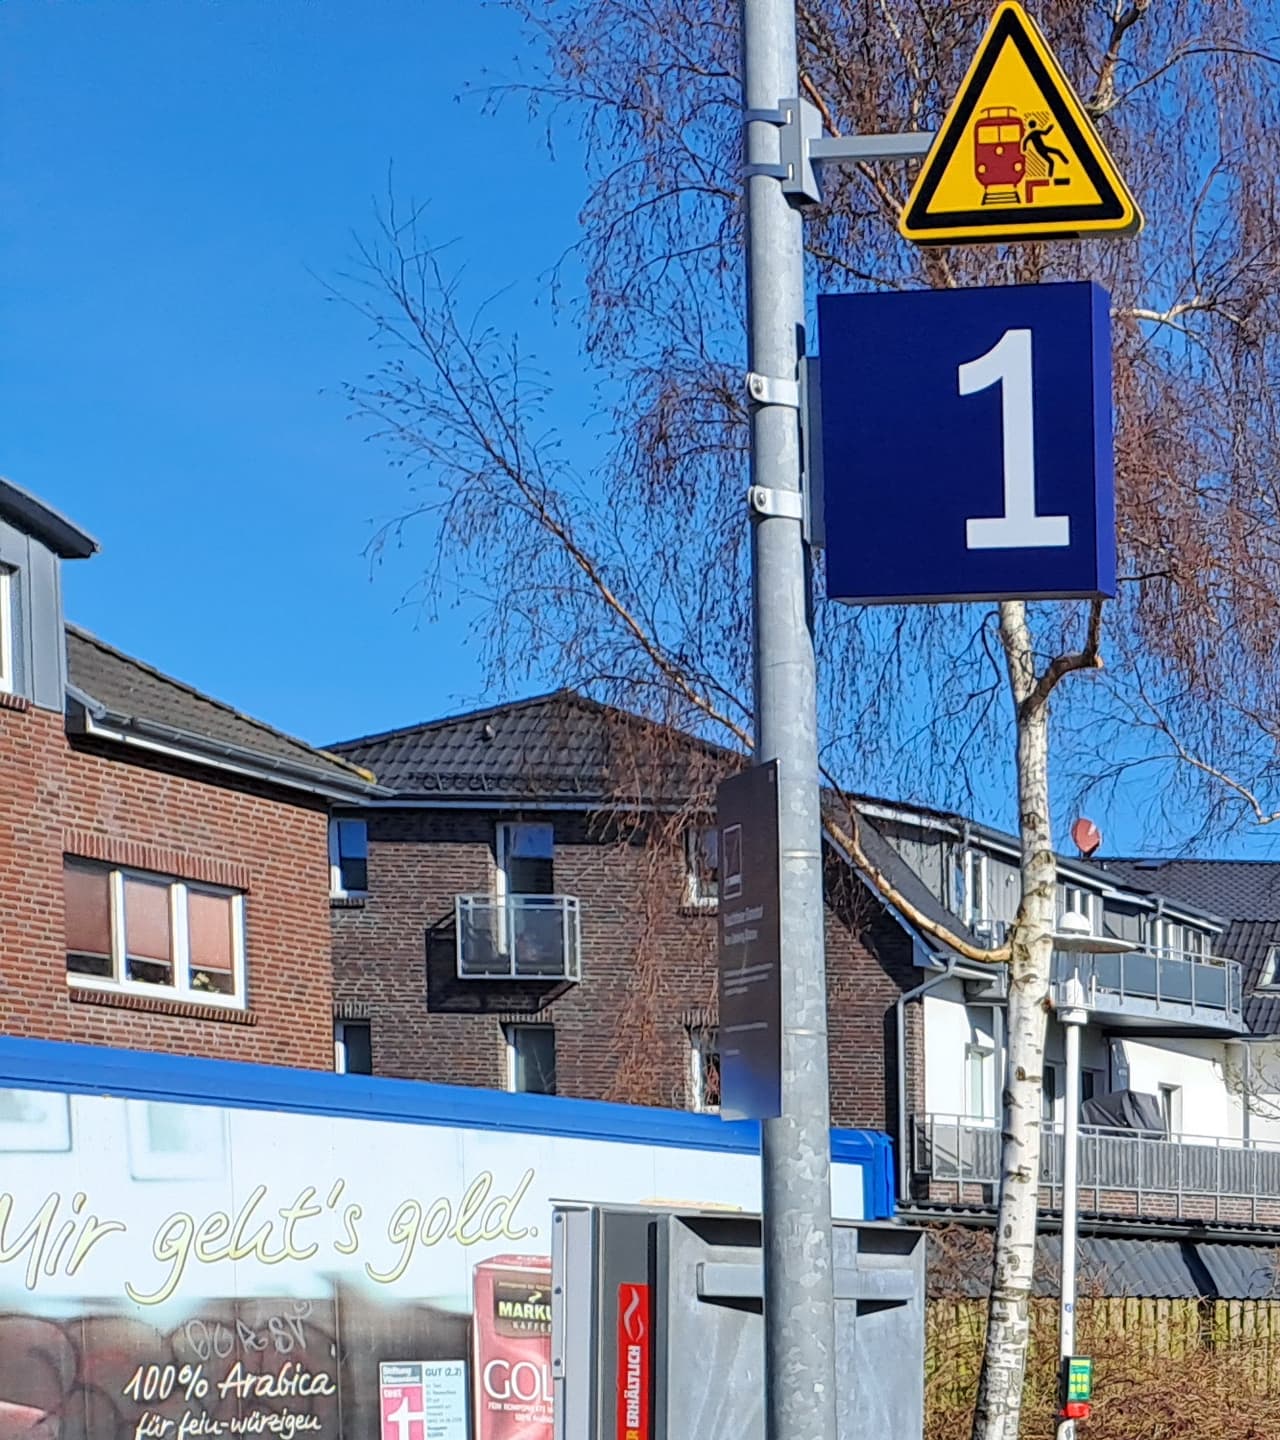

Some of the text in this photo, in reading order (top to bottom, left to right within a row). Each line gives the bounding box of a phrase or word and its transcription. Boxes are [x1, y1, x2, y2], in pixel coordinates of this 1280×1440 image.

[957, 328, 1070, 549] 1
[124, 1178, 362, 1305] geht's
[364, 1168, 539, 1283] gold.
[123, 1361, 336, 1401] 100% Arabica
[425, 1368, 442, 1376] GUT
[624, 1345, 641, 1428] ERHÄLTLICH
